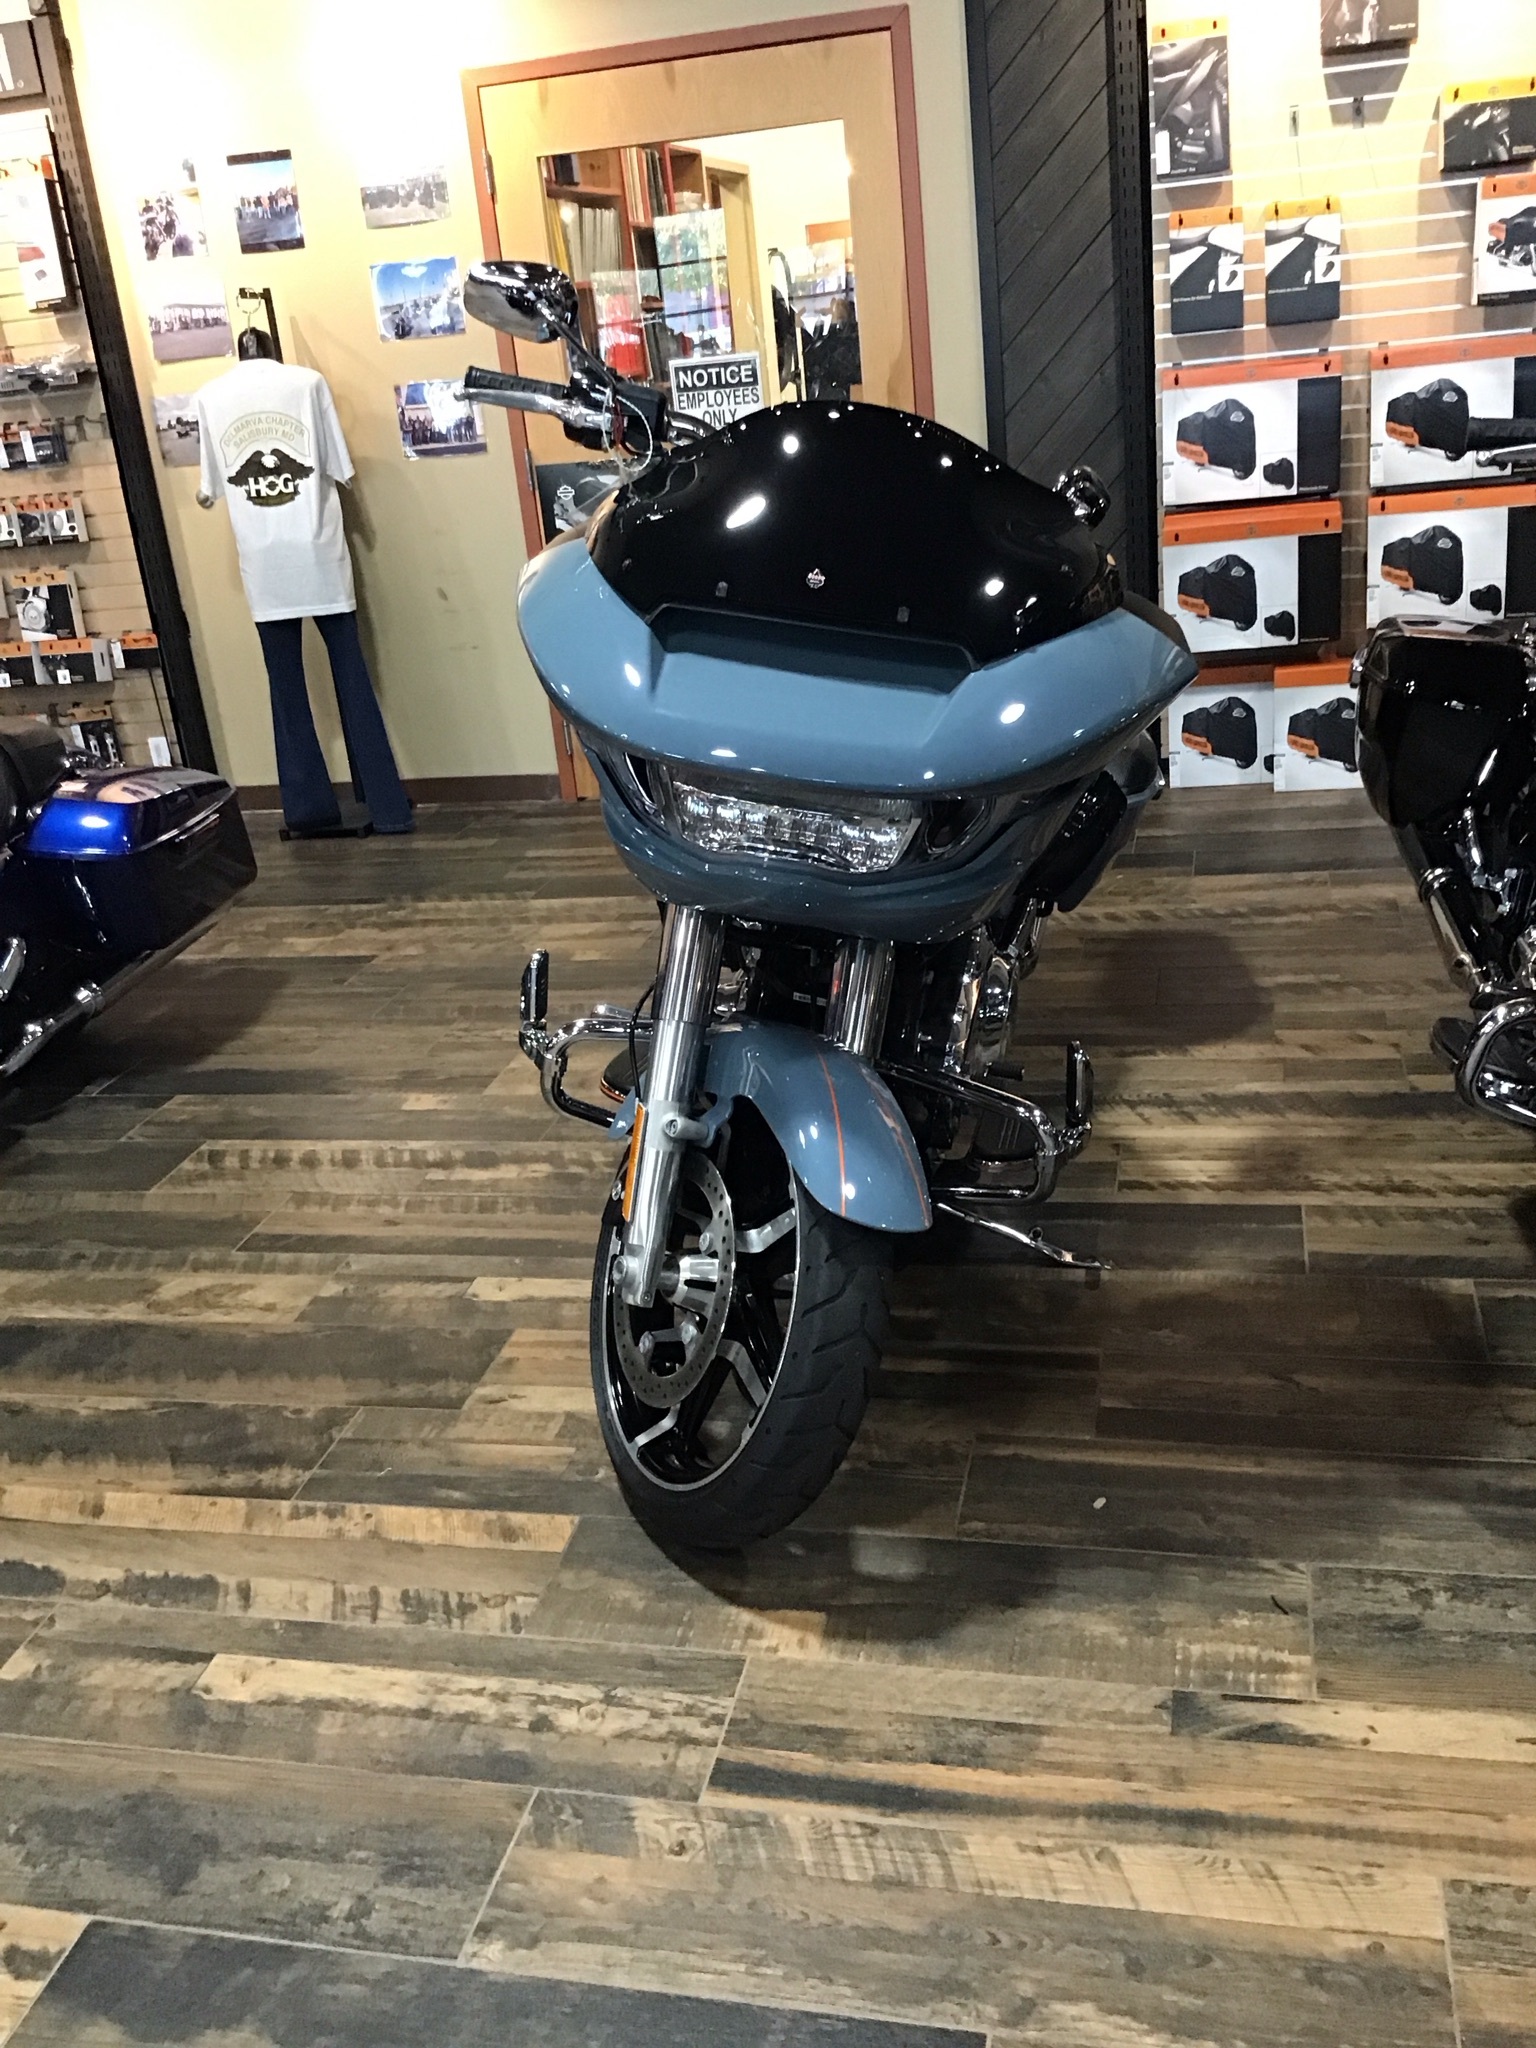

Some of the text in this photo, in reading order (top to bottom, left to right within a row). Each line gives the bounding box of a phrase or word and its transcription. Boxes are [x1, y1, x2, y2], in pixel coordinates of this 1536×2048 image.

[678, 364, 754, 389] NOTICE
[677, 387, 760, 410] EMPLOYEES
[702, 408, 737, 427] ONLY
[223, 415, 306, 448] DELMARVA CHAPTER
[233, 426, 295, 449] SALISBURY MD
[248, 473, 295, 498] HOG
